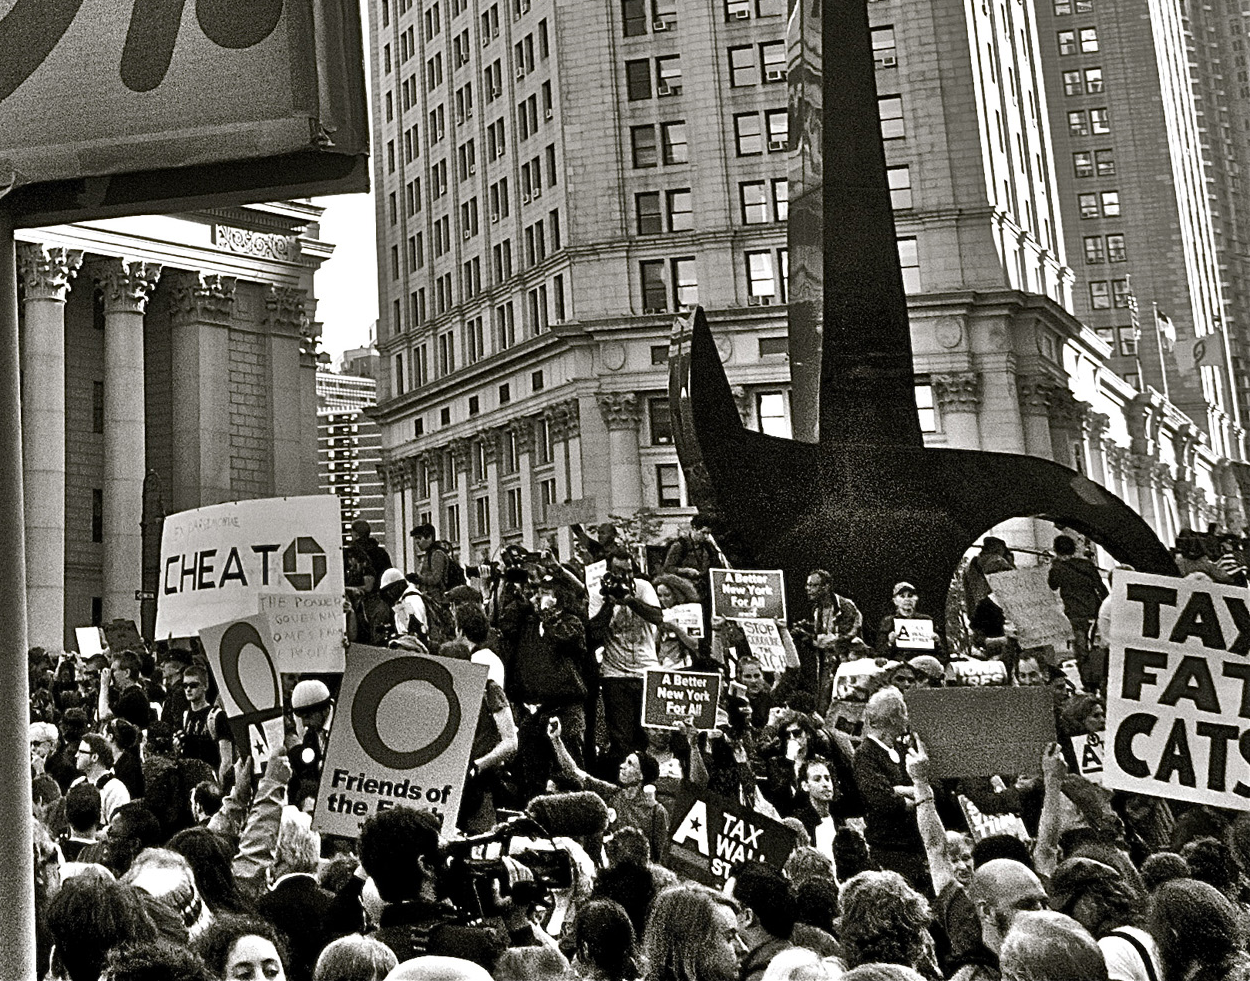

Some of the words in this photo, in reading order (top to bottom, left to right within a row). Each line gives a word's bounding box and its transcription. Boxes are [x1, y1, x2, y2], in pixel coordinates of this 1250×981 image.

[164, 544, 282, 596] CHEAT
[725, 573, 734, 583] A
[735, 573, 768, 584] Better
[722, 583, 746, 594] New
[747, 585, 773, 595] York
[260, 596, 286, 610] THE
[731, 596, 749, 608] For
[750, 596, 766, 608] All
[744, 621, 774, 635] STOP
[662, 673, 671, 685] A
[673, 674, 707, 687] Better
[657, 687, 684, 699] New
[686, 689, 710, 701] York
[666, 701, 686, 715] For
[688, 703, 702, 716] All
[1114, 712, 1250, 798] CAT
[331, 768, 422, 800] Friends
[425, 785, 452, 804] of
[327, 793, 368, 816] the
[672, 800, 710, 856] A
[723, 812, 764, 849] TAX
